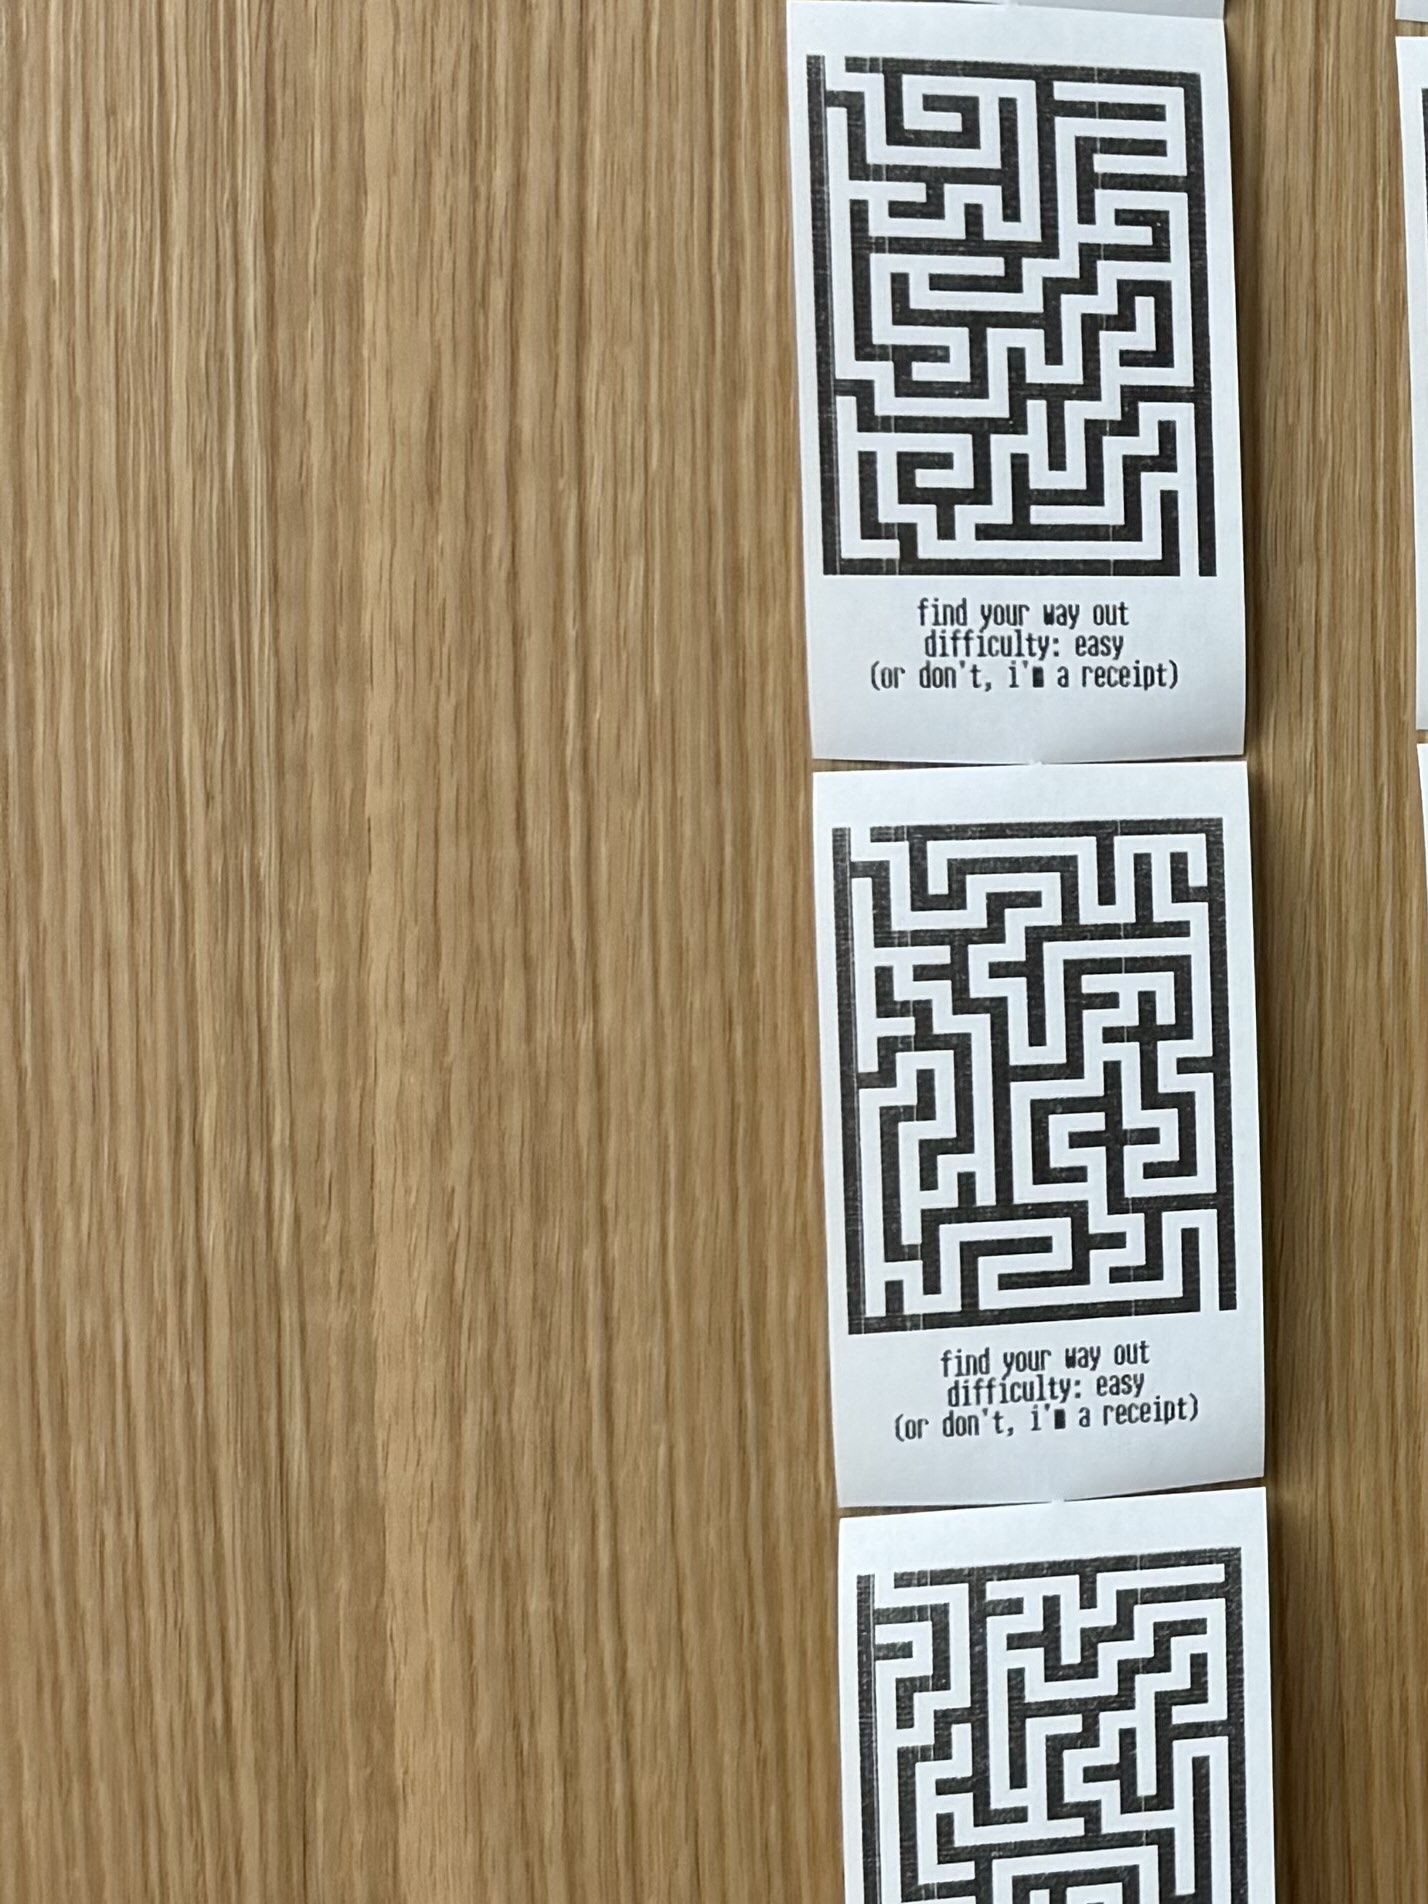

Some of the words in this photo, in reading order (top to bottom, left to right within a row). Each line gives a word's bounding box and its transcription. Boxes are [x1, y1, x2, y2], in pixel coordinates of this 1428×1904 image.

[918, 598, 967, 626] find
[981, 604, 1030, 631] your
[1043, 604, 1079, 630] way
[1093, 602, 1129, 626] out
[925, 629, 1059, 661] difficulty:
[1075, 635, 1123, 660] easy
[871, 661, 905, 691] (or
[919, 660, 991, 692] don't,
[1057, 666, 1069, 688] a
[1082, 660, 1178, 691] receipt)
[941, 1347, 990, 1377] find
[1003, 1350, 1051, 1378] your
[1065, 1346, 1101, 1371] way
[1114, 1341, 1149, 1365] out
[948, 1374, 1081, 1407] difficulty:
[1096, 1373, 1144, 1398] easy
